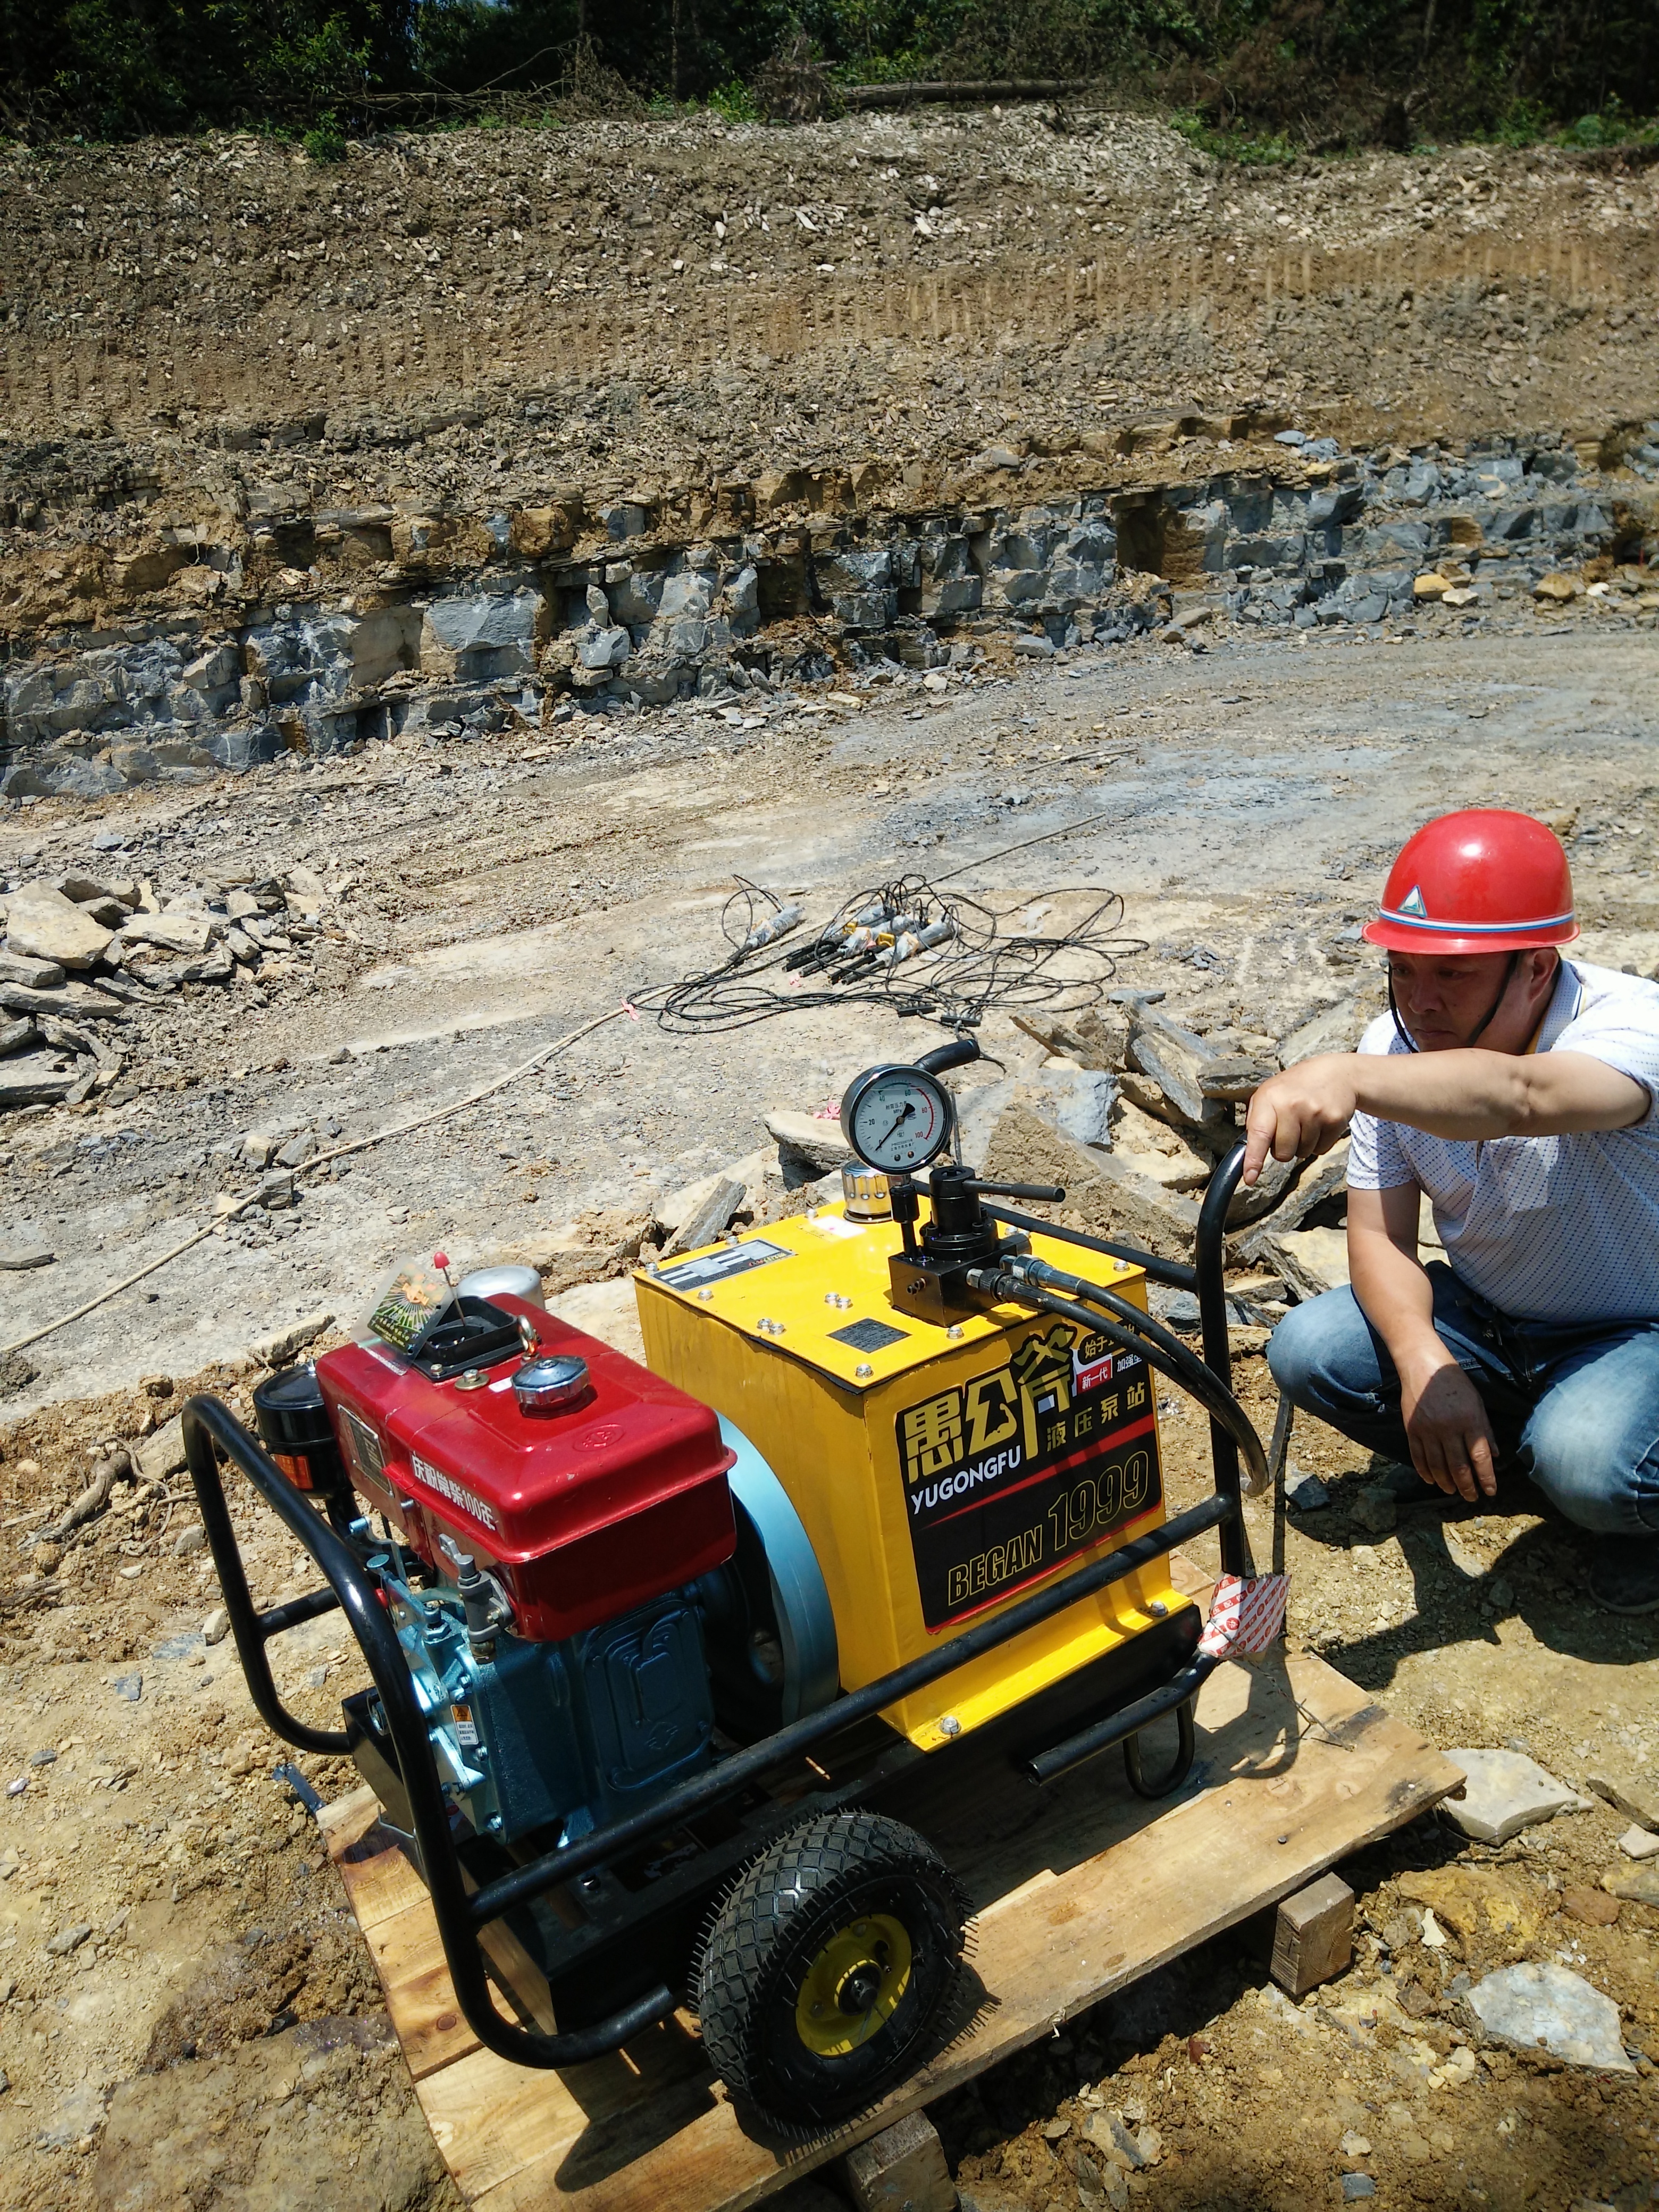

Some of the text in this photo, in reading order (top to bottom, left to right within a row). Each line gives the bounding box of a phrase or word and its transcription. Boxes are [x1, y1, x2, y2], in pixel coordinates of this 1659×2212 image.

[1082, 1367, 1108, 1389] 新一代
[1047, 1382, 1144, 1452] 液压泵站
[412, 1451, 496, 1531] 庆祝常柴100年
[911, 1445, 1020, 1515] YUGONGFU
[948, 1451, 1149, 1606] BEGAN 1999
